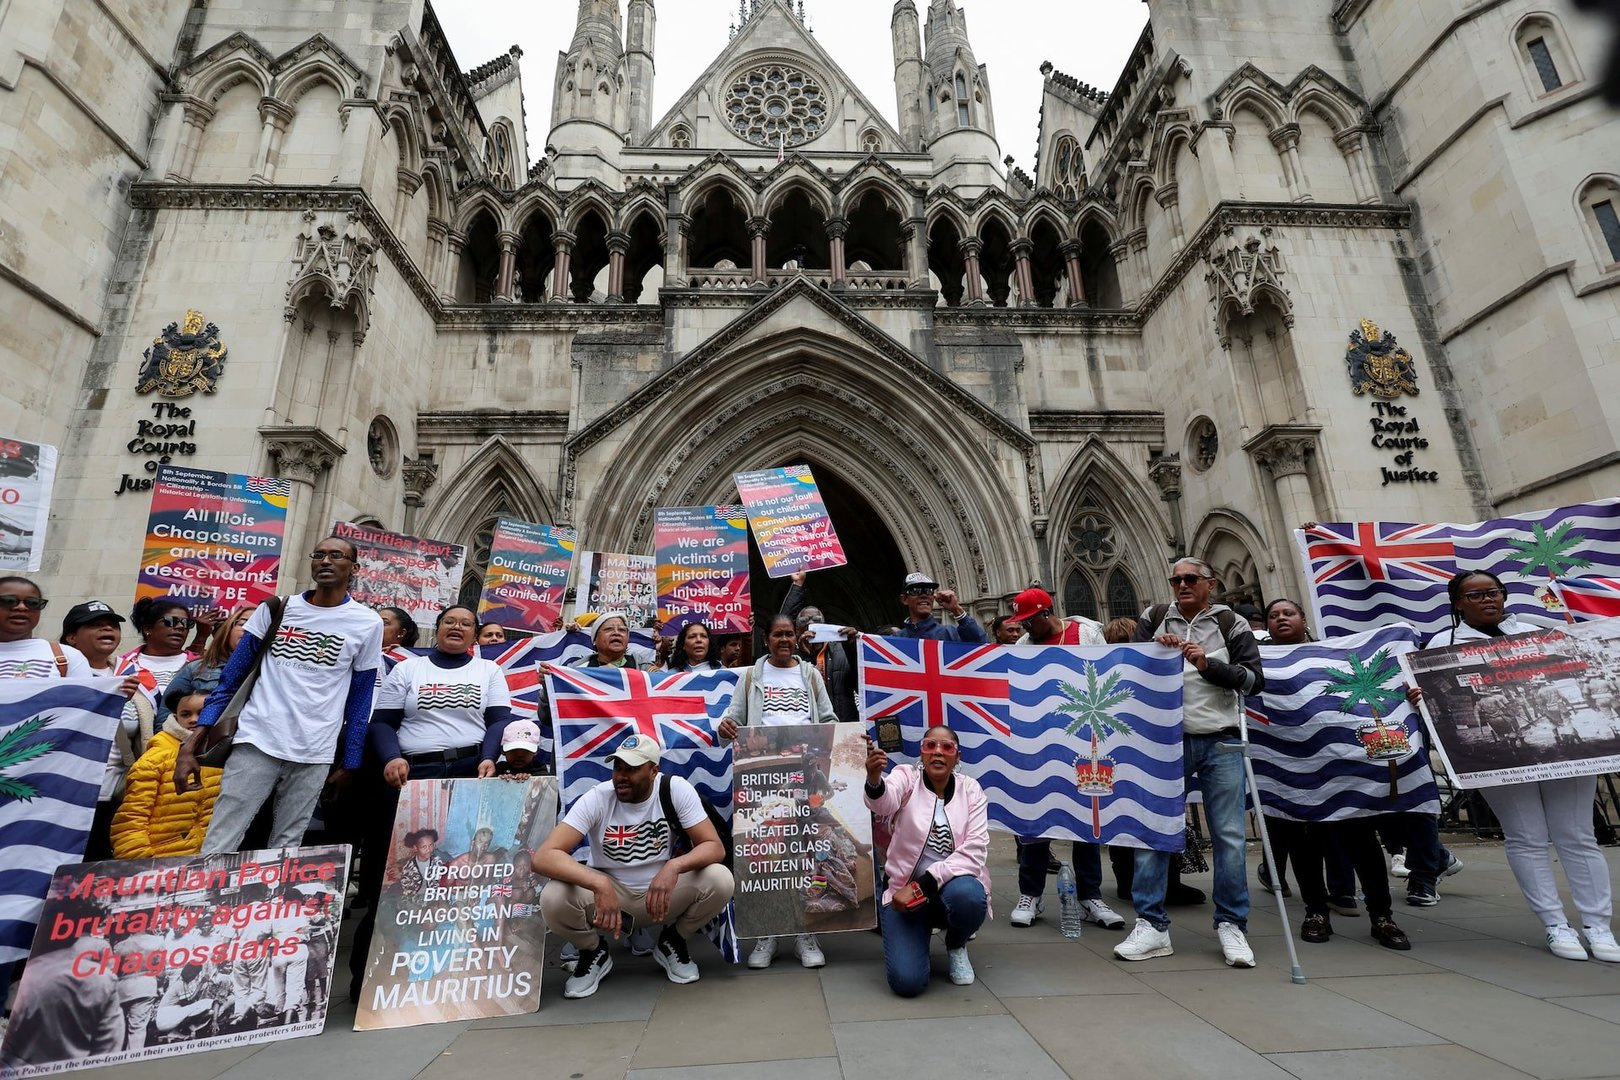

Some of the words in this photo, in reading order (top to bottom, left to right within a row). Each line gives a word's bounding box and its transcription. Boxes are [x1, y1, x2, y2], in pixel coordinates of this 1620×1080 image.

[152, 402, 191, 418] The
[1372, 402, 1406, 416] The
[137, 419, 195, 439] Royal
[1370, 418, 1420, 436] Royal
[127, 438, 196, 454] Courts
[1372, 434, 1429, 450] Courts
[1394, 450, 1414, 466] of
[161, 476, 199, 486] Nationality
[175, 470, 214, 480] September,
[1381, 467, 1439, 487] Justice
[166, 482, 204, 492] Citizenship
[193, 492, 228, 500] Legislative
[230, 497, 262, 505] Unfairness
[766, 497, 778, 506] not
[795, 492, 813, 501] fault
[777, 503, 810, 514] children
[183, 508, 208, 522] All
[215, 510, 254, 526] Illois
[757, 516, 787, 527] cannot
[789, 514, 800, 522] be
[801, 511, 820, 520] born
[811, 520, 825, 531] you
[153, 524, 277, 547] Chagossians
[336, 523, 413, 548] Mauritian
[418, 539, 452, 556] Govt
[678, 538, 698, 548] We
[703, 538, 724, 546] are
[764, 536, 798, 548] banned
[800, 534, 808, 542] us
[809, 530, 828, 540] from
[170, 546, 210, 560] and
[216, 548, 258, 563] their
[784, 545, 809, 555] home
[810, 541, 818, 550] in
[819, 540, 833, 548] the
[383, 552, 439, 572] respect
[670, 554, 717, 564] victims
[721, 551, 734, 562] of
[774, 557, 802, 568] Indian
[803, 550, 835, 562] Ocean!
[144, 563, 273, 583] descendants
[493, 556, 516, 568] Our
[519, 560, 565, 576] families
[502, 573, 532, 585] must
[534, 576, 550, 588] be
[598, 570, 656, 580] GOVERNM
[672, 568, 733, 581] Historical
[167, 584, 220, 598] MUST
[226, 586, 247, 600] BE
[496, 586, 550, 603] reunited!
[606, 582, 642, 592] STOLE
[674, 584, 733, 600] Injustice.
[396, 594, 444, 613] rights
[591, 594, 656, 604] COMPENSA
[666, 604, 689, 615] The
[694, 602, 711, 613] UK
[716, 602, 742, 612] can
[1490, 651, 1549, 668] oppress
[1495, 660, 1589, 682] Chagossians
[742, 772, 788, 786] BRITISH
[744, 824, 798, 838] TREATED
[802, 823, 819, 835] AS
[734, 842, 786, 856] SECOND
[790, 840, 831, 854] CLASS
[424, 863, 515, 881] UPROOTED
[748, 859, 799, 874] CITIZEN
[802, 858, 814, 871] IN
[56, 864, 228, 900] Mauritian
[238, 858, 336, 886] Police
[741, 876, 812, 893] MAURITIUS
[424, 886, 491, 902] BRITISH
[50, 903, 204, 940] brutality
[212, 894, 334, 929] against
[396, 904, 512, 926] CHAGOSSIAN
[418, 928, 477, 947] LIVING
[482, 926, 500, 942] IN
[71, 936, 301, 979] Chagossians
[390, 946, 518, 976] POVERTY
[372, 972, 532, 1010] MAURITIUS
[22, 1066, 50, 1075] Police
[65, 1061, 79, 1069] the
[82, 1053, 128, 1066] fore-front
[144, 1048, 165, 1056] their
[167, 1045, 184, 1053] way
[197, 1037, 232, 1048] disperse
[249, 1027, 288, 1041] protesters
[291, 1023, 317, 1032] during
